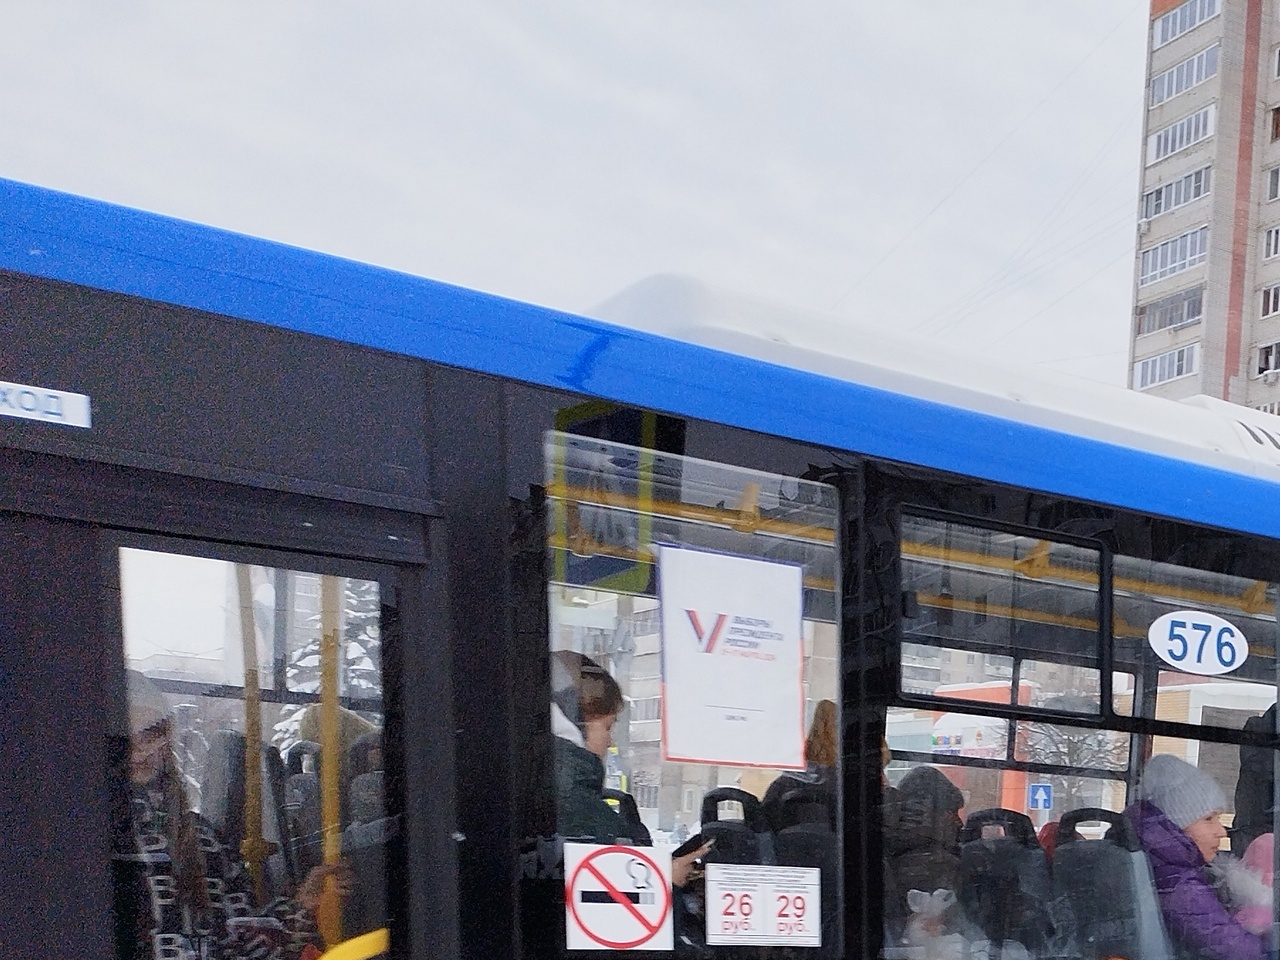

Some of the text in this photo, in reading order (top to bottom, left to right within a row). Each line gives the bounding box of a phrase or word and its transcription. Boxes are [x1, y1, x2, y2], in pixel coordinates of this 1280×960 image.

[1167, 620, 1236, 668] 576
[721, 893, 753, 917] 26
[776, 895, 806, 919] 29
